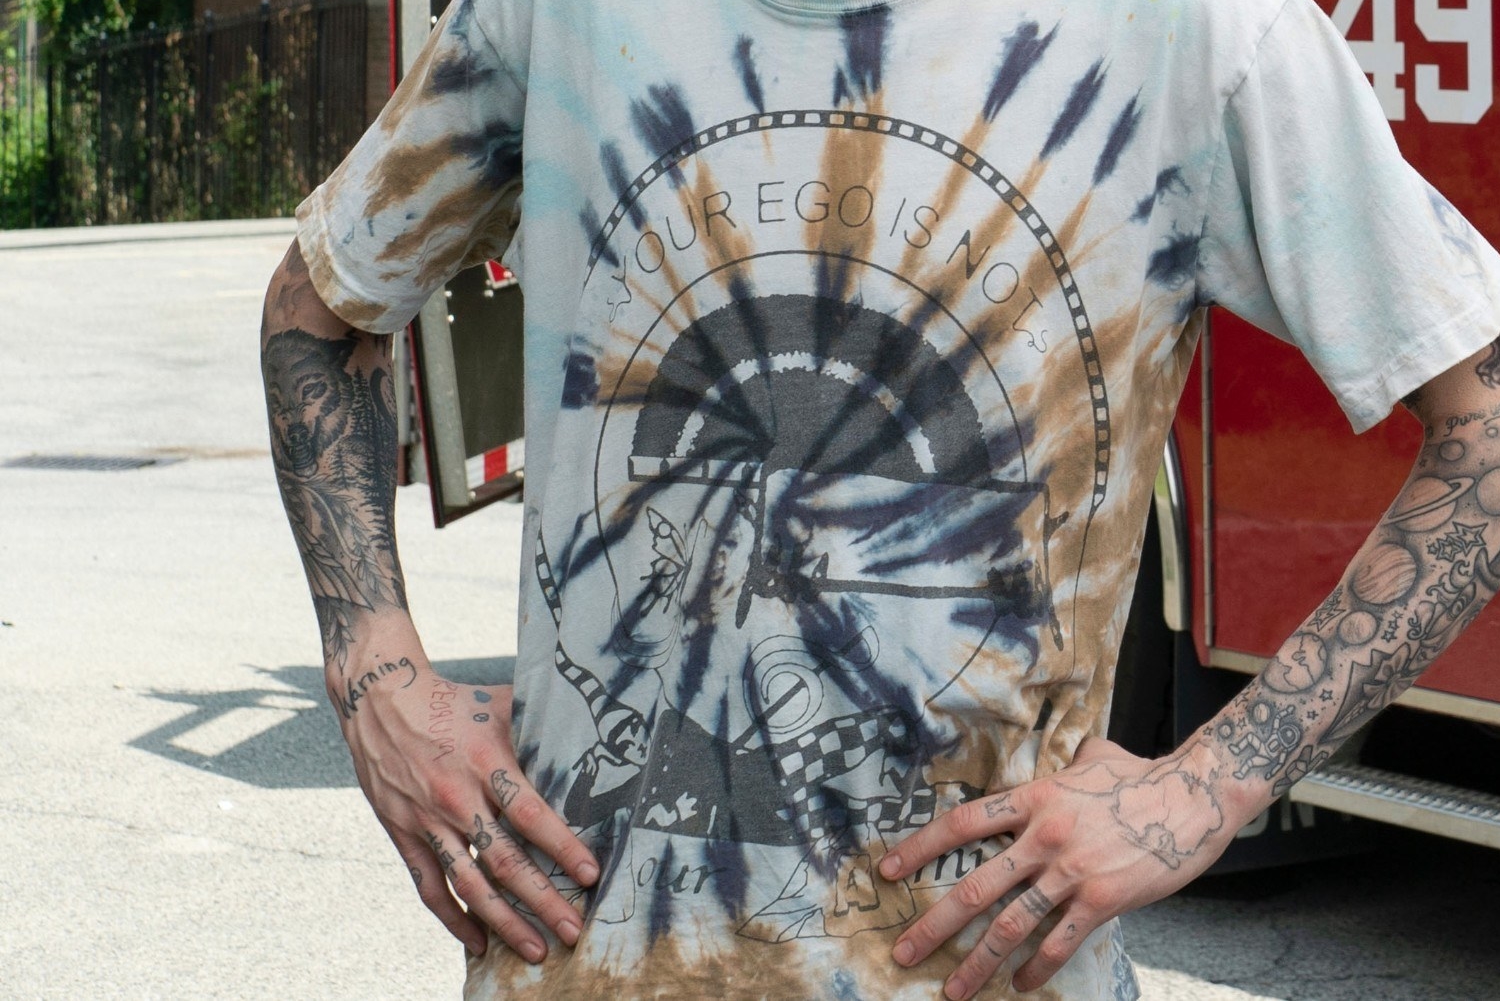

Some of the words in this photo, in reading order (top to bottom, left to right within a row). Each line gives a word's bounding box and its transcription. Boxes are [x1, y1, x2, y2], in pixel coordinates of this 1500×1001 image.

[607, 190, 737, 308] YOUR
[757, 180, 874, 228] EGO
[889, 197, 941, 250] IS
[946, 229, 1046, 343] NOT
[1443, 410, 1486, 437] Pure
[332, 657, 417, 719] Warning
